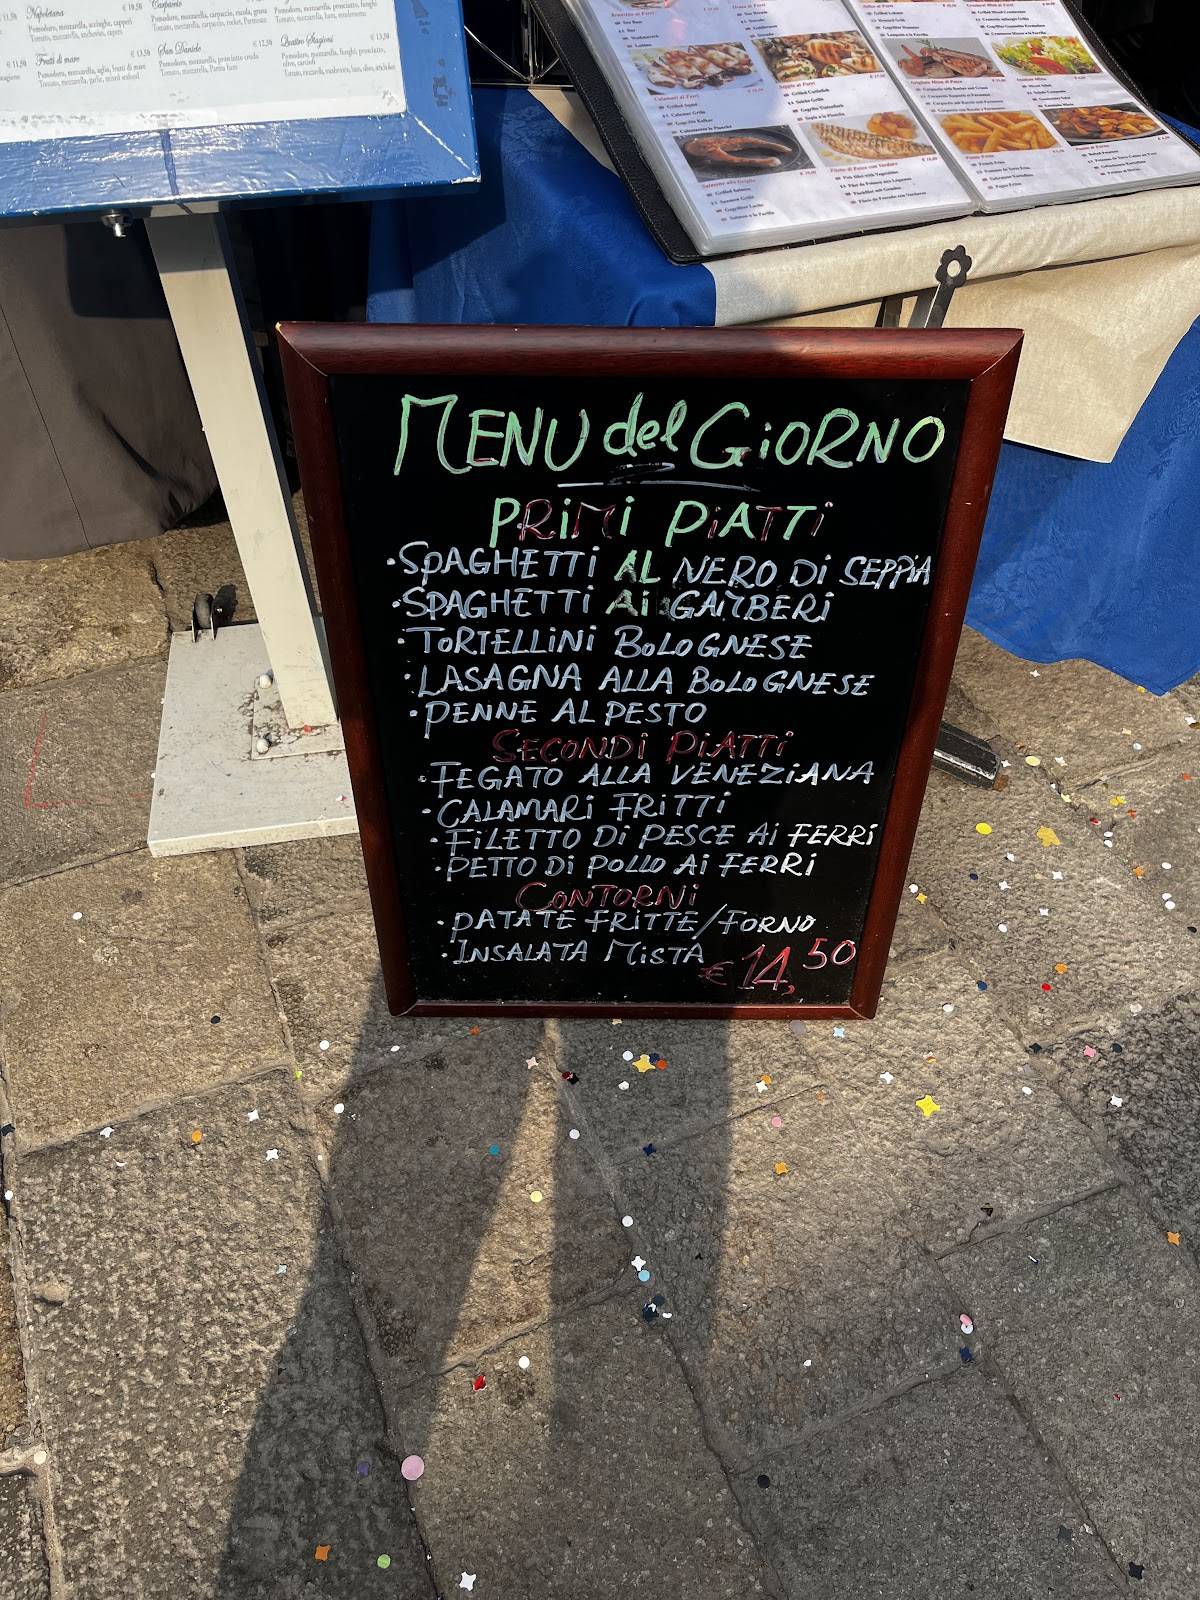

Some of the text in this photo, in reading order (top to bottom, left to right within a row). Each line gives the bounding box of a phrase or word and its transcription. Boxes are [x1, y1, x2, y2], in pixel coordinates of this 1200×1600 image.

[393, 393, 588, 476] MENU
[603, 392, 687, 457] del
[613, 549, 661, 584] AL
[672, 554, 777, 588] NERO
[417, 662, 583, 698] LASAGNA
[598, 664, 673, 694] ALLA
[424, 697, 707, 739] PENNE AL PESTO
[430, 761, 563, 799] FEGATO
[578, 762, 651, 787] ALLA
[638, 823, 736, 850] PESCE
[446, 856, 538, 882] PETTO
[586, 853, 667, 879] POLLO
[450, 908, 576, 943] PATATE
[453, 939, 588, 965] INSALATA
